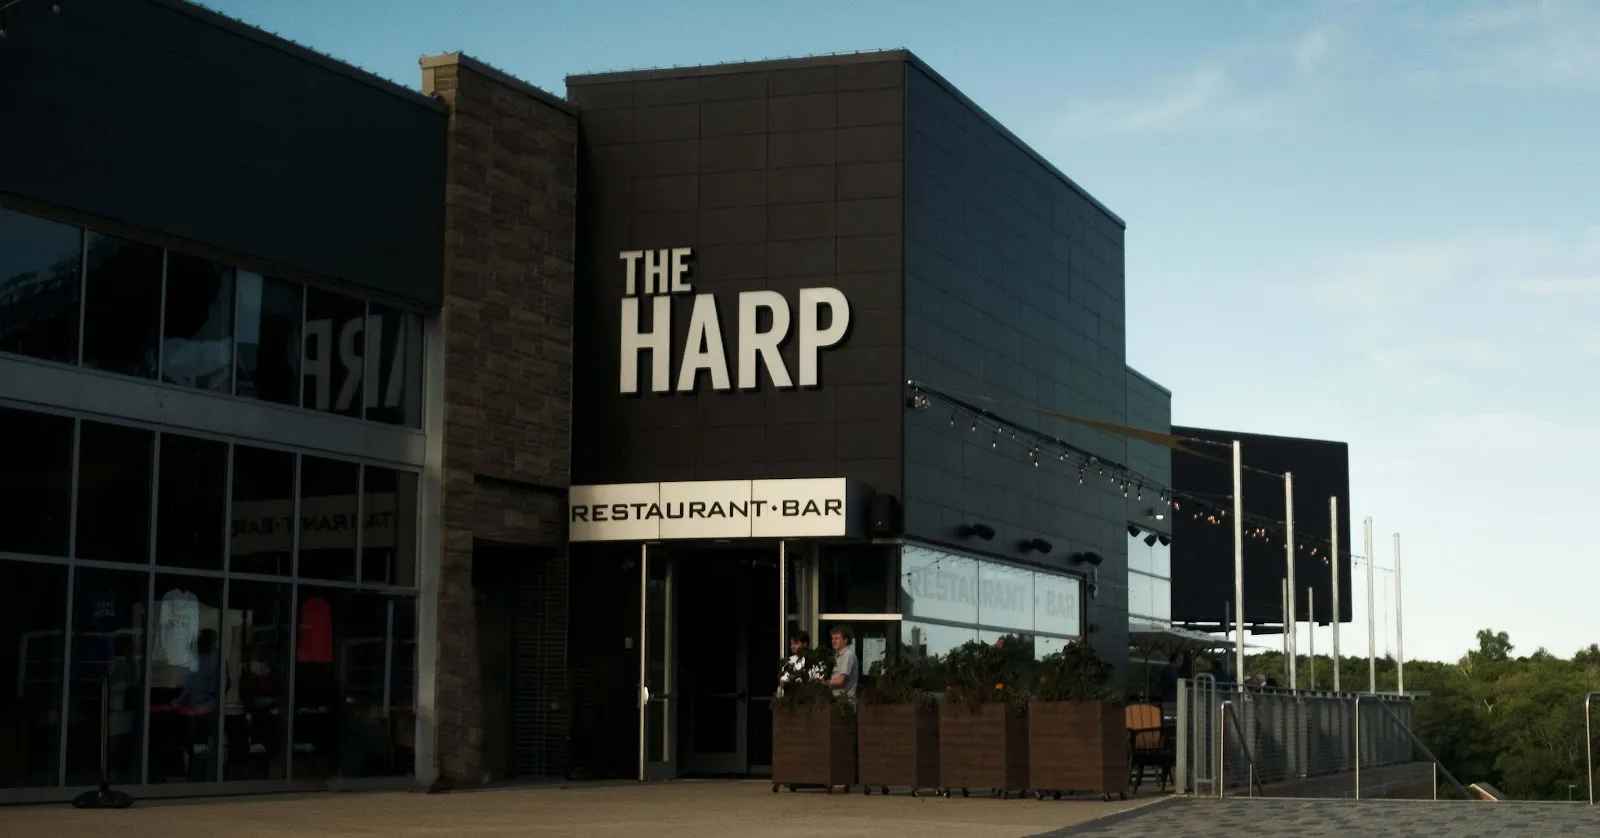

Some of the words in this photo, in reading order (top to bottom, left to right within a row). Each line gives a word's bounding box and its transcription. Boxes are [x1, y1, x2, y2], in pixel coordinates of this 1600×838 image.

[619, 247, 693, 295] THE
[619, 286, 851, 395] HARP
[571, 501, 767, 521] RESTAURANT
[782, 498, 843, 517] BAR
[1046, 588, 1076, 620] BAR
